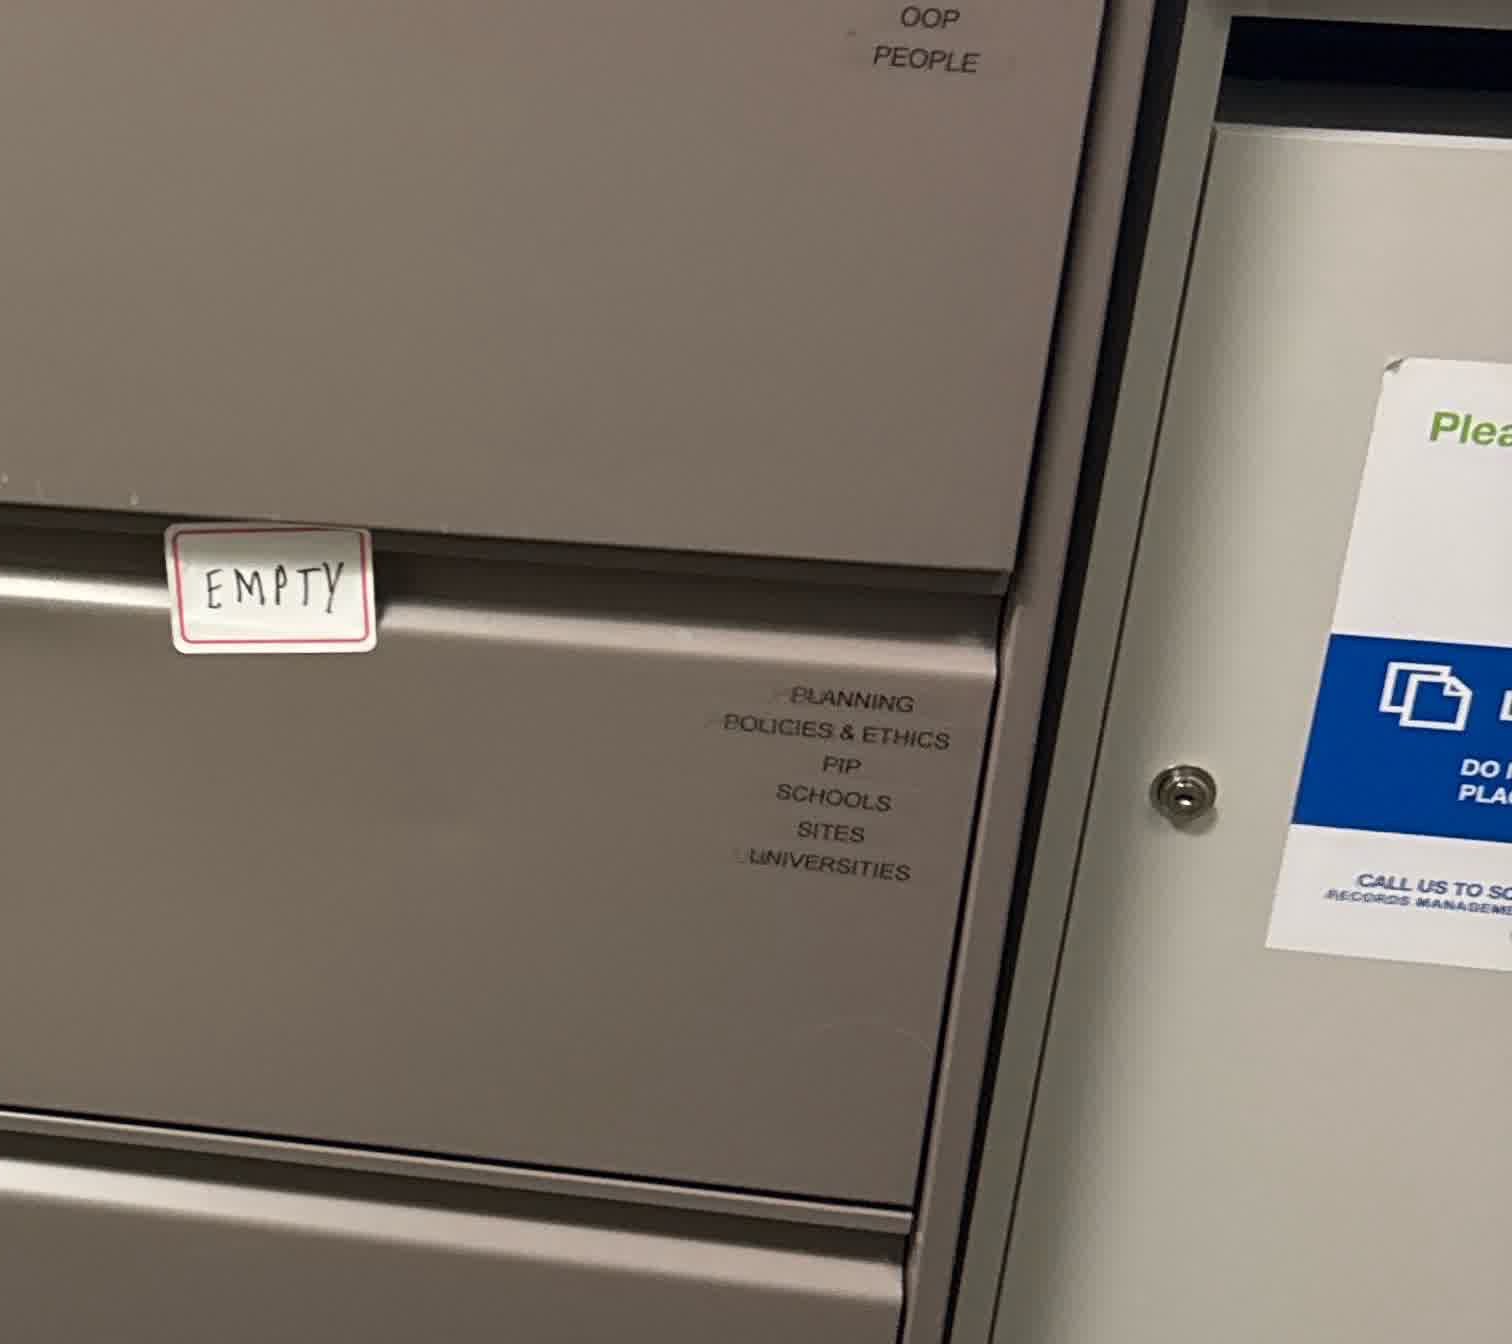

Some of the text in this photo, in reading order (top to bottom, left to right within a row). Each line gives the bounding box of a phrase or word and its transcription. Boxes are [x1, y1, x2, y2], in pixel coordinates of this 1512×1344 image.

[900, 6, 961, 29] OOP
[872, 45, 982, 73] PEOPLE
[206, 561, 344, 614] EMPTY
[791, 685, 915, 713] PLANNING
[723, 713, 951, 751] POLICIES & ETHICS
[822, 755, 862, 775] PIP
[1461, 758, 1500, 778] DO
[776, 783, 893, 813] SCHOOLS
[1458, 783, 1512, 805] PLA
[797, 820, 865, 843] SITES
[749, 848, 912, 882] UNIVERSITIES
[1325, 889, 1411, 907] RECORDS
[1357, 873, 1413, 892] CALL
[1417, 879, 1449, 895] US
[1453, 882, 1484, 898] TO
